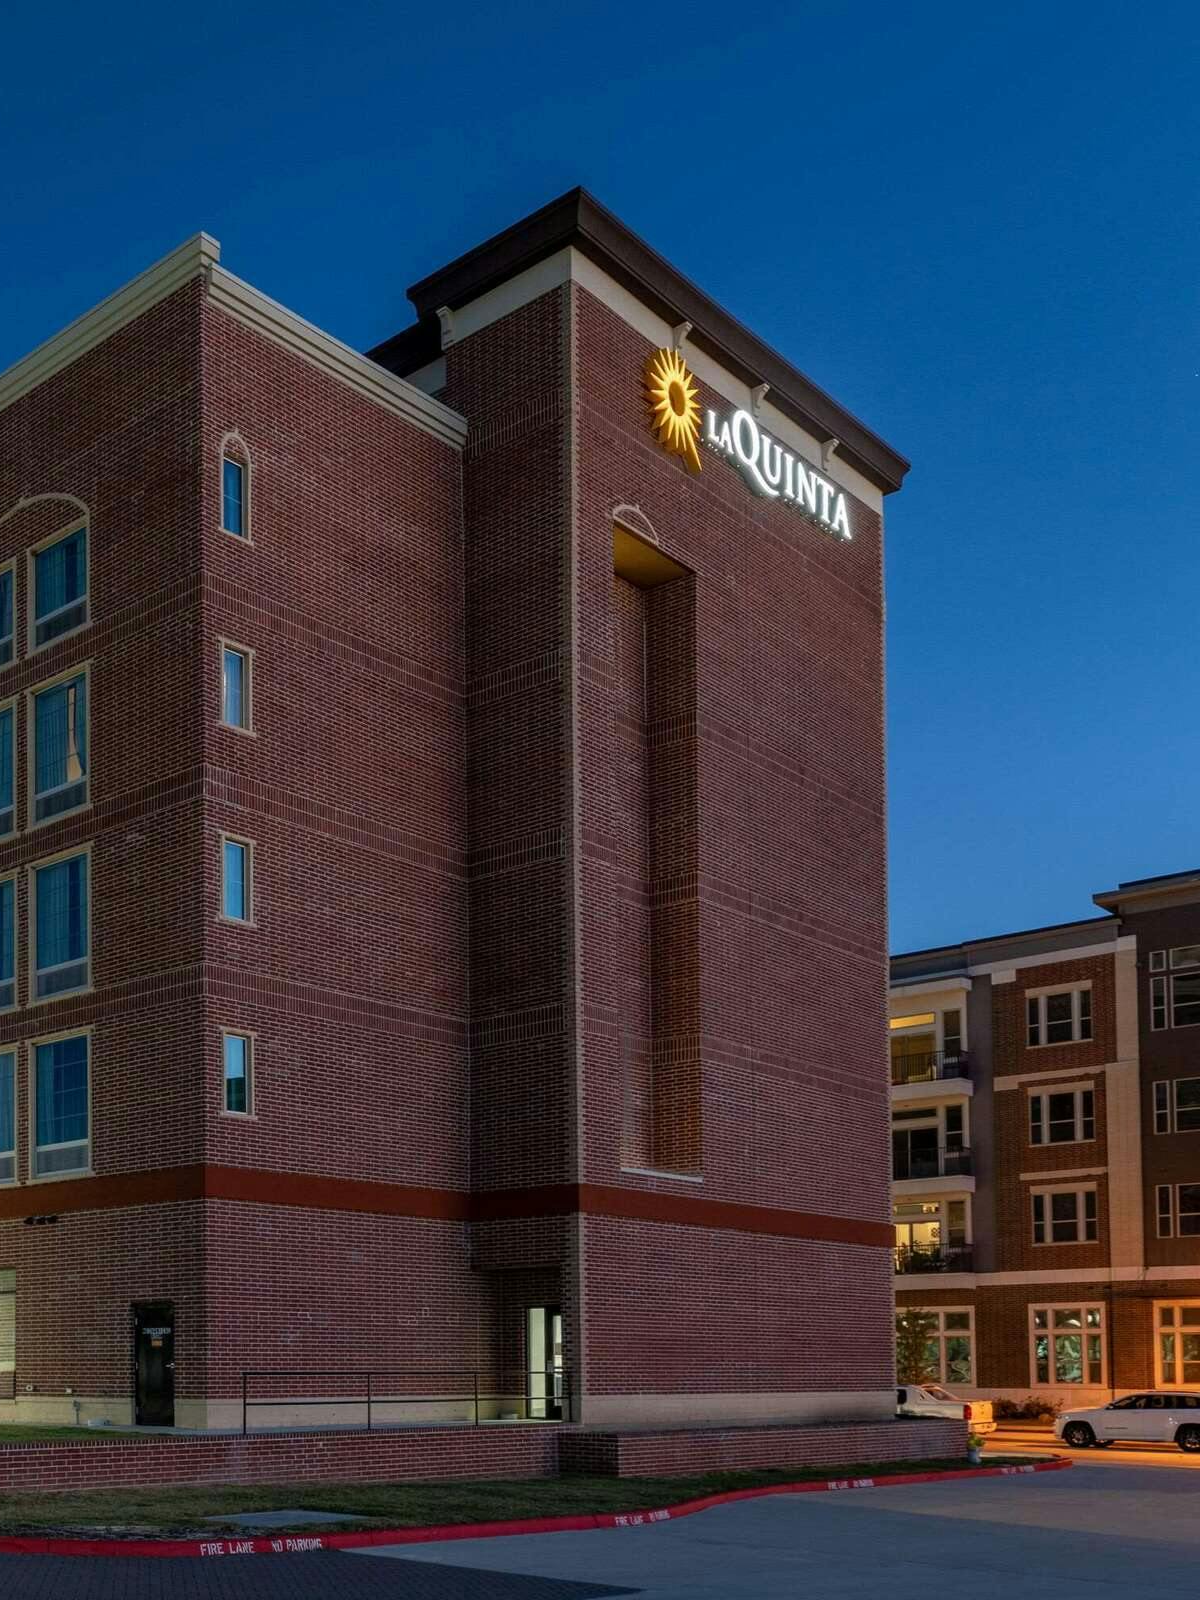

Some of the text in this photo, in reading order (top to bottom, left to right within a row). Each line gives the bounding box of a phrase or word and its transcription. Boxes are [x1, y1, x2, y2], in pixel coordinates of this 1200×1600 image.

[707, 409, 852, 540] LA QUINTA
[200, 1538, 322, 1556] FIRE LANE NO PARKING
